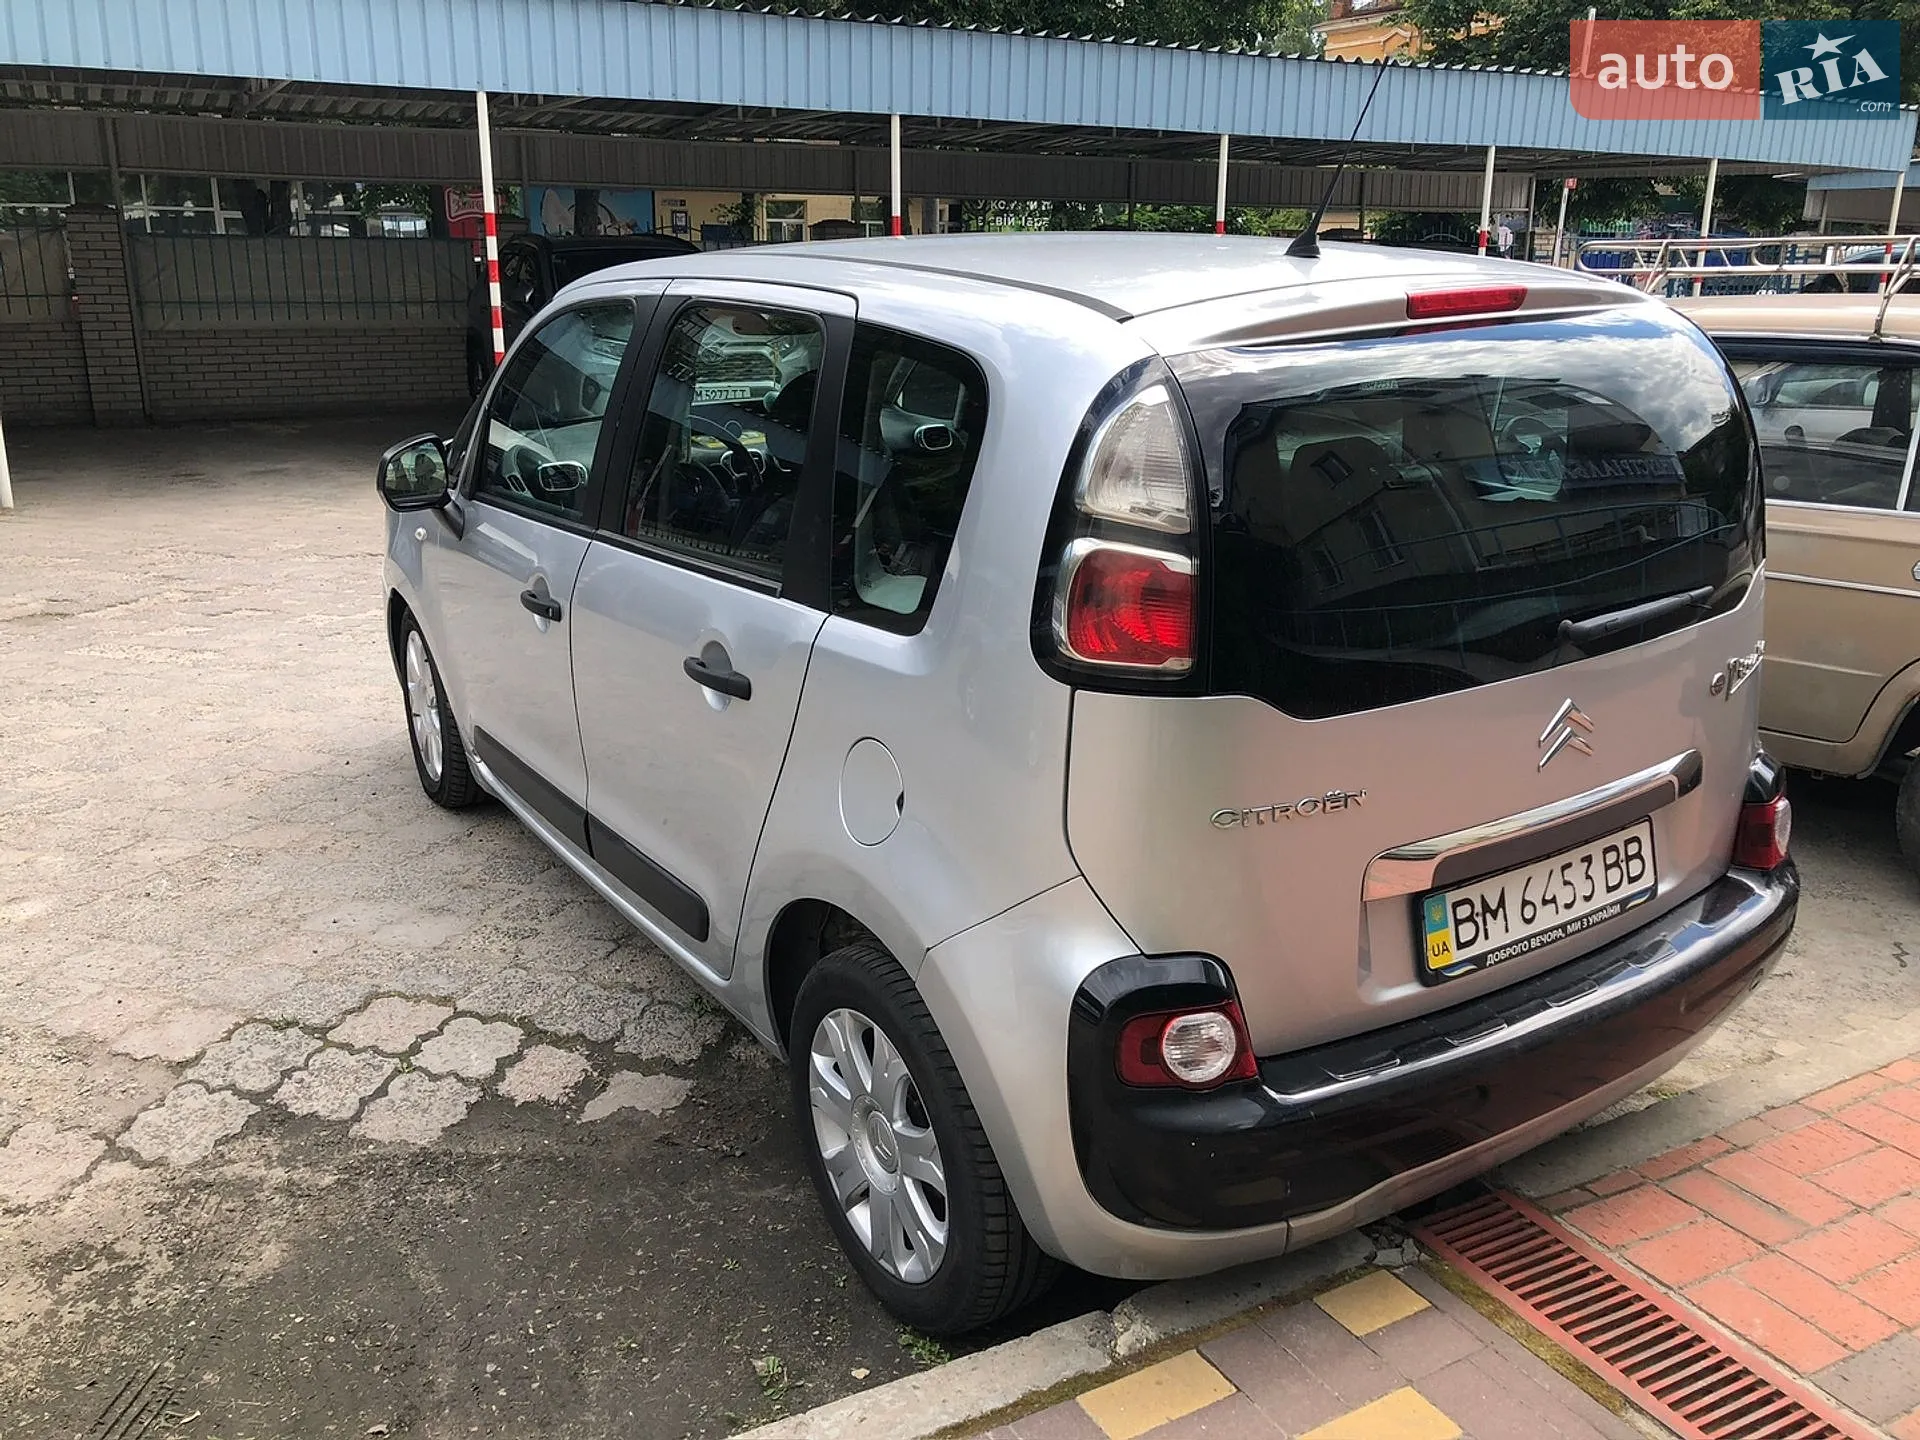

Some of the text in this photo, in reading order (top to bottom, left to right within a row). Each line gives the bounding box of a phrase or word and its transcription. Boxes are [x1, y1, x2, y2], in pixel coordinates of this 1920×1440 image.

[1452, 835, 1646, 951] BM 6453 BB
[1431, 942, 1451, 958] UA
[1486, 940, 1529, 966] ДОБРОГО
[1566, 921, 1582, 935] МИ
[1588, 903, 1621, 925] УКРАЇНИ
